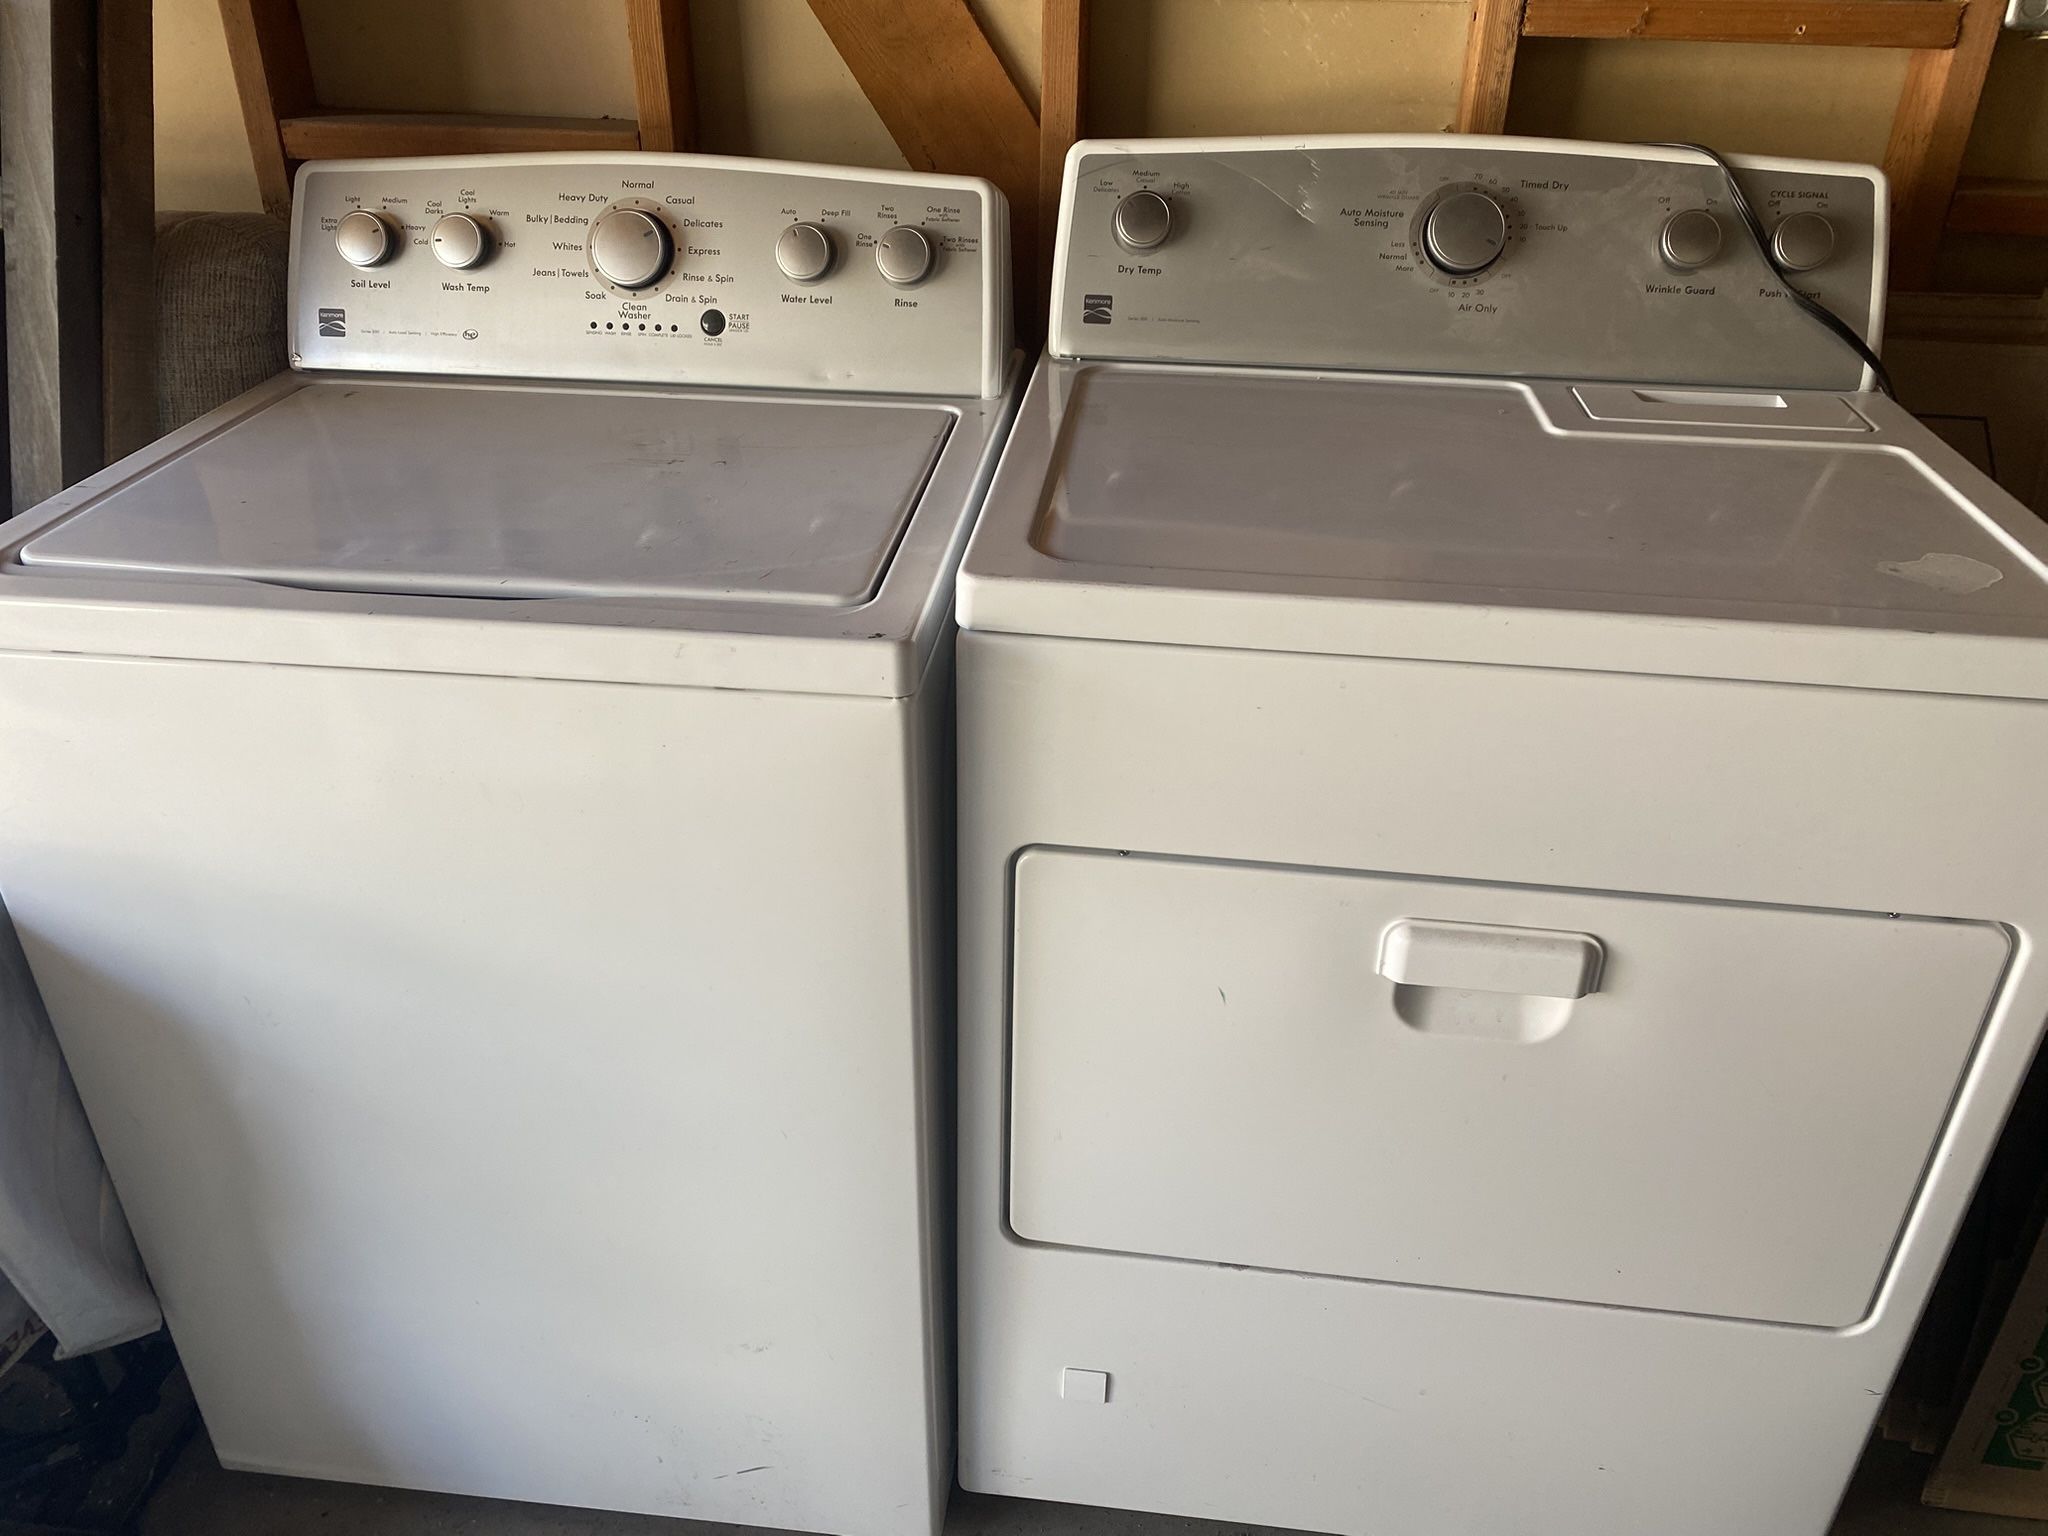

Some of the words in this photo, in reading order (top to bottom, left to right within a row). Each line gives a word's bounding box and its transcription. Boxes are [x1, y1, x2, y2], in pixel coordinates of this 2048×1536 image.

[1132, 169, 1160, 178] Medium
[622, 180, 654, 189] Normal
[1100, 179, 1113, 187] Low
[1173, 181, 1190, 190] High
[1520, 180, 1549, 190] Timed
[1552, 180, 1570, 192] Dry
[345, 195, 361, 203] Light
[559, 193, 586, 203] Heavy
[589, 194, 608, 204] Duty
[1770, 190, 1795, 199] CYCLE
[1798, 191, 1829, 199] SIGNAL
[382, 196, 408, 204] Medium
[427, 200, 442, 208] Cool
[458, 196, 477, 204] Lights
[665, 196, 695, 205] Casual
[1657, 197, 1671, 205] Off
[1767, 200, 1781, 208] Off
[425, 207, 444, 215] Darks
[489, 209, 510, 217] Warm
[781, 208, 797, 216] Auto
[821, 209, 839, 218] Deep
[841, 209, 851, 217] Fill
[926, 206, 941, 214] One
[943, 207, 961, 215] Rinse
[1340, 208, 1362, 217] Auto
[1364, 209, 1404, 218] Moisture
[526, 215, 548, 225] Bulky
[554, 216, 589, 226] Bedding
[877, 212, 898, 220] Rinses
[321, 217, 338, 225] Extra
[683, 219, 723, 228] Delicates
[1354, 218, 1389, 229] Sensing
[321, 224, 337, 232] Light
[405, 224, 425, 232] Heavy
[1557, 225, 1568, 233] Up
[413, 238, 429, 246] Cold
[856, 240, 873, 248] Rinse
[958, 236, 978, 244] Rinses
[552, 242, 583, 251] Whites
[688, 247, 721, 257] Express
[1379, 253, 1407, 261] Normal
[532, 268, 556, 277] Jeans
[561, 269, 589, 278] Towels
[1118, 264, 1135, 276] Dry
[1138, 265, 1162, 277] Temp
[683, 273, 705, 282] Rinse
[715, 274, 734, 284] Spin
[350, 280, 366, 288] Soil
[369, 280, 391, 289] Level
[442, 283, 464, 292] Wash
[467, 284, 490, 294] Temp
[1645, 285, 1681, 295] Wrinkle
[1685, 286, 1716, 296] Guard
[1759, 288, 1782, 298] Push
[585, 291, 607, 300] Soak
[665, 294, 688, 303] Drain
[699, 295, 717, 305] Spin
[781, 294, 807, 304] Water
[810, 295, 833, 305] Level
[622, 302, 647, 311] Clean
[894, 299, 918, 308] Rinse
[1458, 303, 1472, 312] Air
[1474, 304, 1498, 314] Only
[618, 311, 651, 320] Washer
